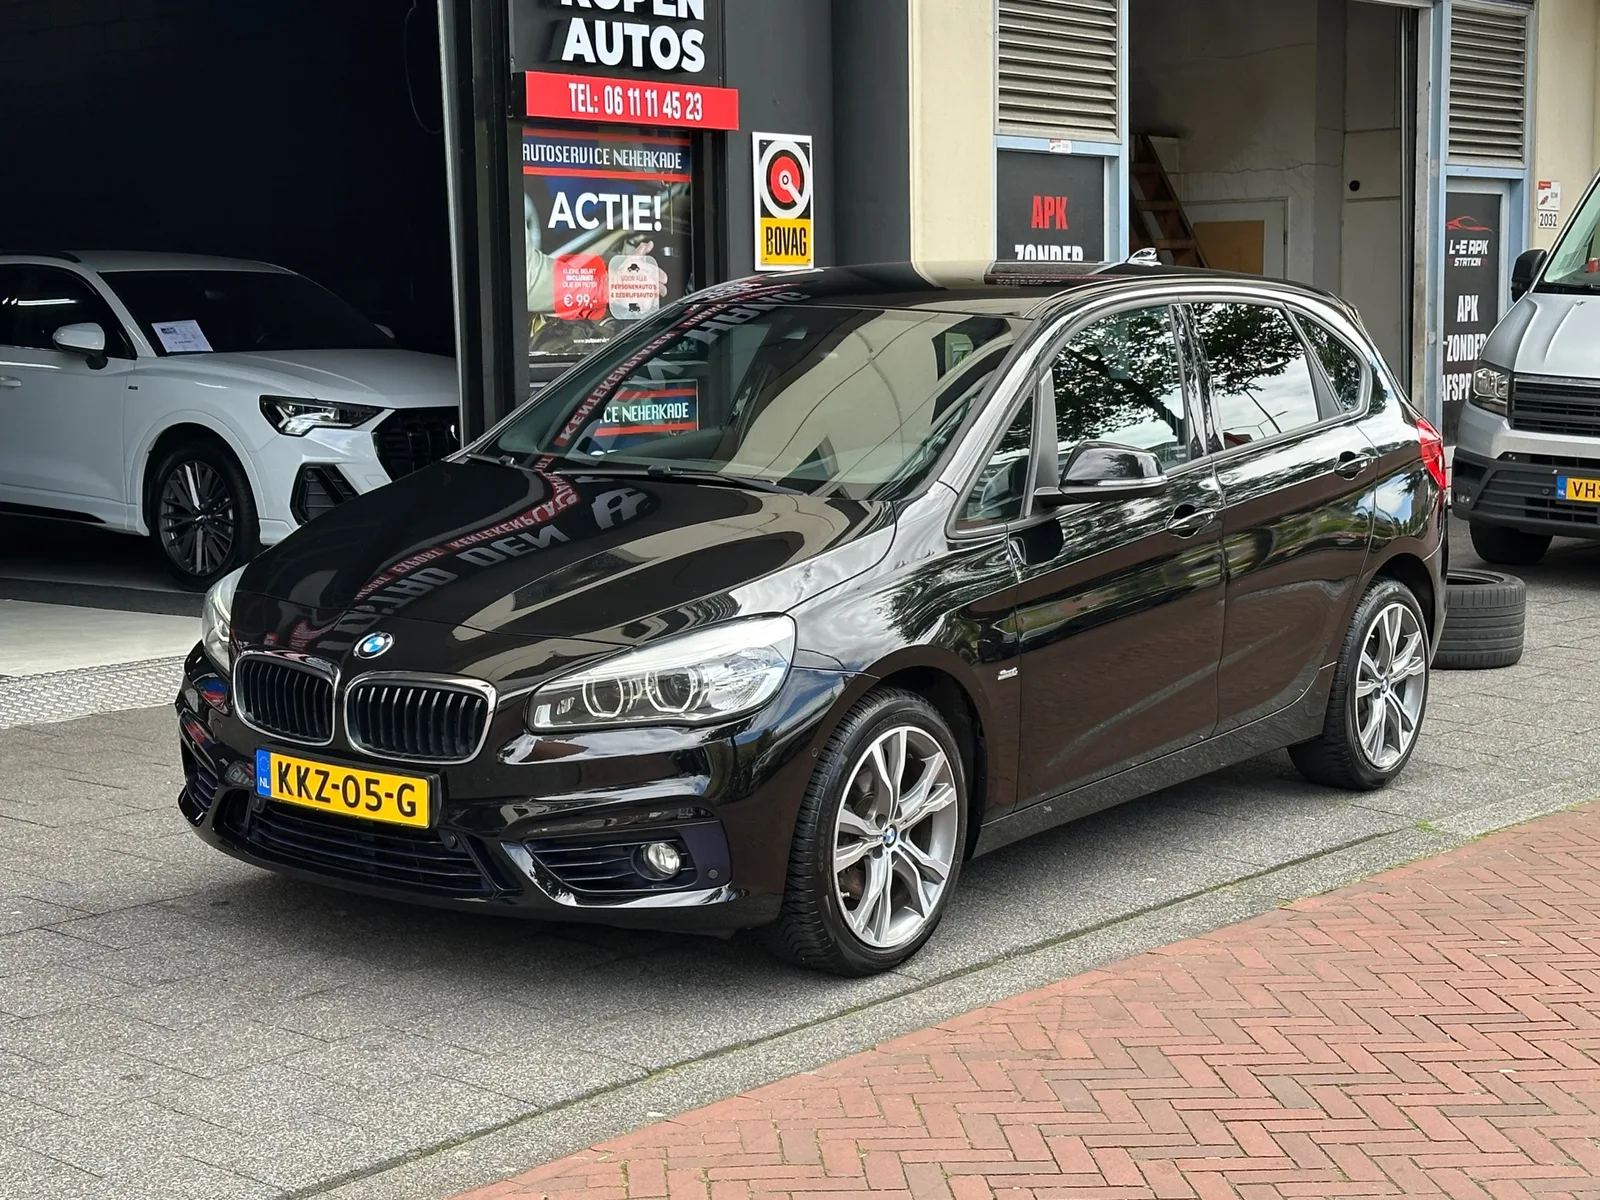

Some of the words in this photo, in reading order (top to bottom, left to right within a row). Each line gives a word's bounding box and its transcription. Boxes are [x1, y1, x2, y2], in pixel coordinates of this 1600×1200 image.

[561, 17, 705, 73] AUTOS
[568, 82, 599, 113] TEL:
[603, 85, 623, 115] 06
[627, 87, 641, 116] 11
[644, 89, 658, 117] 11
[662, 90, 681, 119] 45
[685, 91, 702, 121] 23
[522, 143, 610, 165] AUTOSERVICE
[613, 149, 682, 169] NEHERKADE
[548, 191, 662, 232] ACTIE!
[1031, 195, 1068, 230] APK
[1540, 213, 1557, 227] 2032
[766, 226, 807, 257] BOVAG
[1454, 257, 1481, 267] STATION
[563, 293, 573, 307] €
[1457, 295, 1478, 323] APK
[622, 402, 689, 422] NEHERKADE
[1573, 481, 1600, 499] VH
[259, 777, 270, 789] NL
[277, 760, 416, 818] KKZ-05-G
